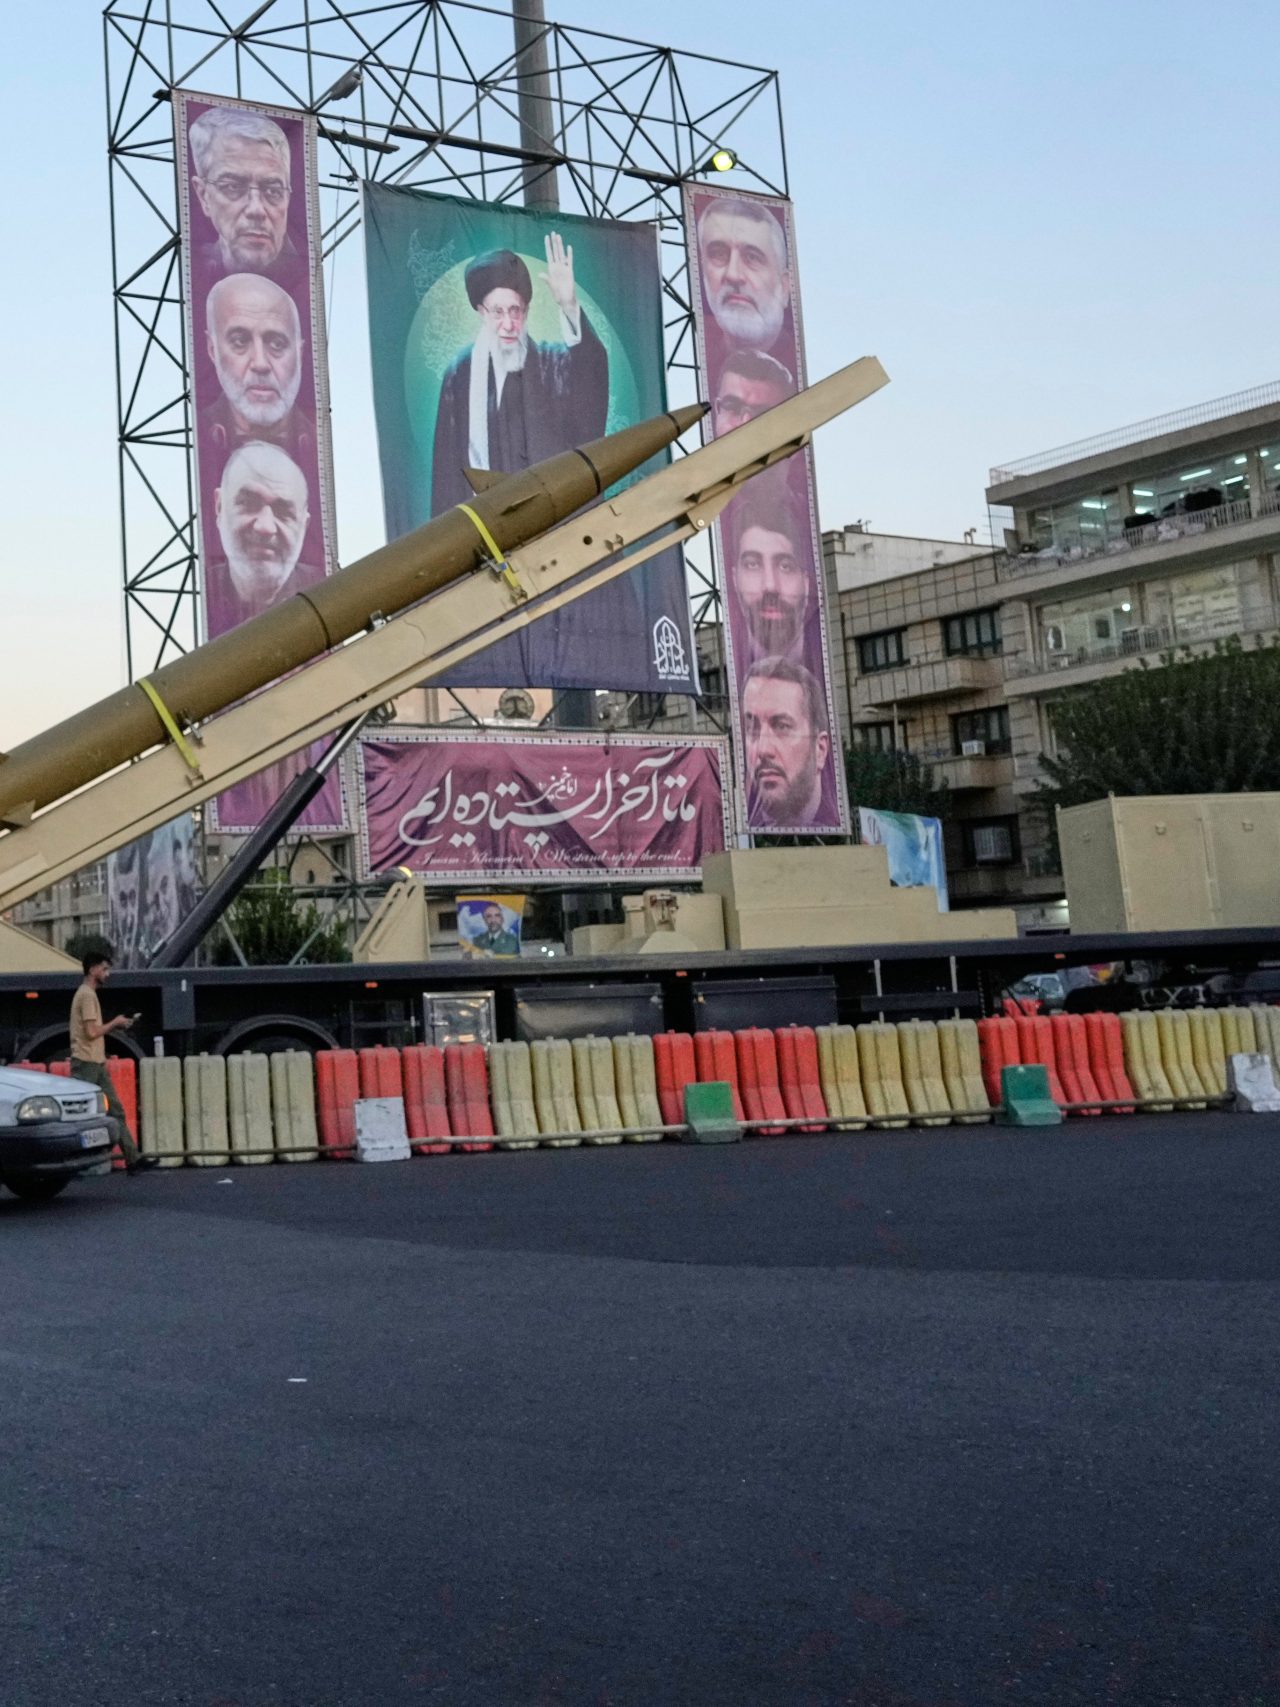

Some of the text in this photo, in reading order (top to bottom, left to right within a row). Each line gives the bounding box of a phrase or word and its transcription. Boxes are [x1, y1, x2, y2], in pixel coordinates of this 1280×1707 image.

[588, 749, 675, 841] آخر
[662, 773, 688, 822] تا
[680, 793, 696, 822] ما
[421, 851, 460, 865] Imam
[639, 849, 656, 862] the
